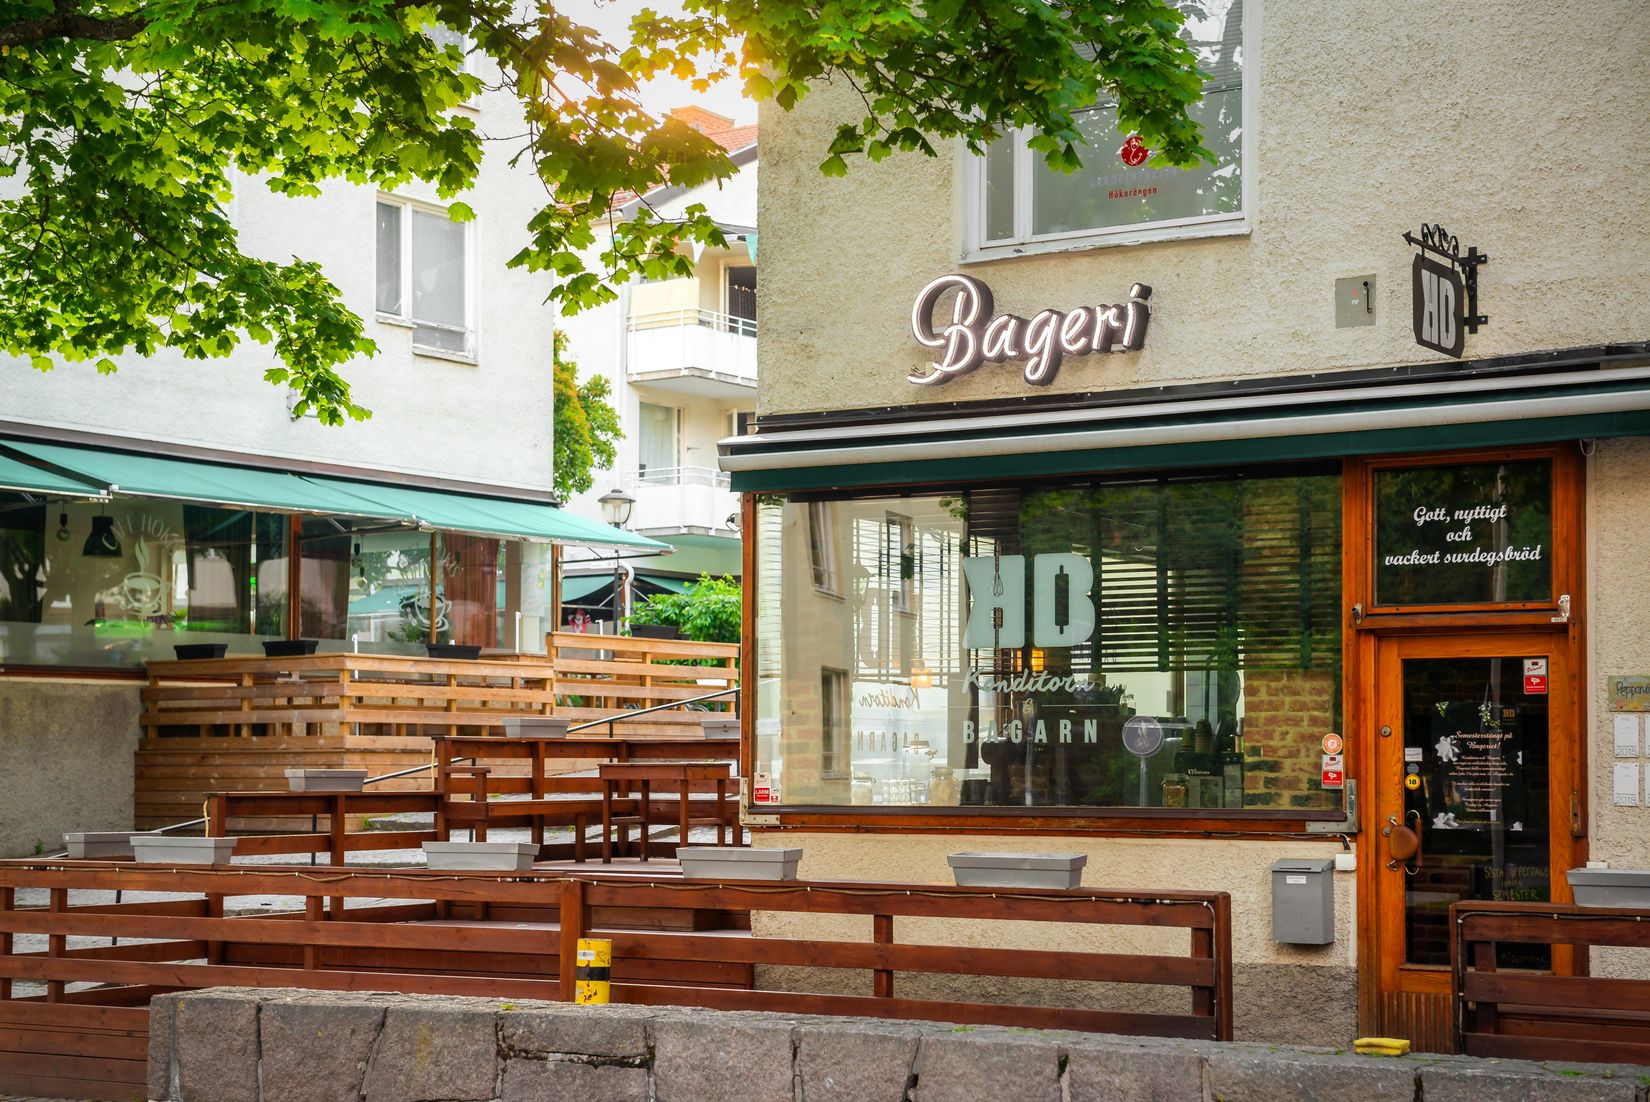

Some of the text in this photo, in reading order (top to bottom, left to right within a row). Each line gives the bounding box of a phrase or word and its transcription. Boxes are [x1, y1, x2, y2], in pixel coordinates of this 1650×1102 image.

[907, 273, 1153, 386] Bageri
[1413, 505, 1508, 527] Gott, nyttigt
[1446, 526, 1473, 542] och
[1384, 544, 1542, 567] vackert surdegsbröd
[961, 666, 1097, 694] Konditorn
[962, 718, 1099, 744] BAGARN
[1408, 778, 1417, 786] 18
